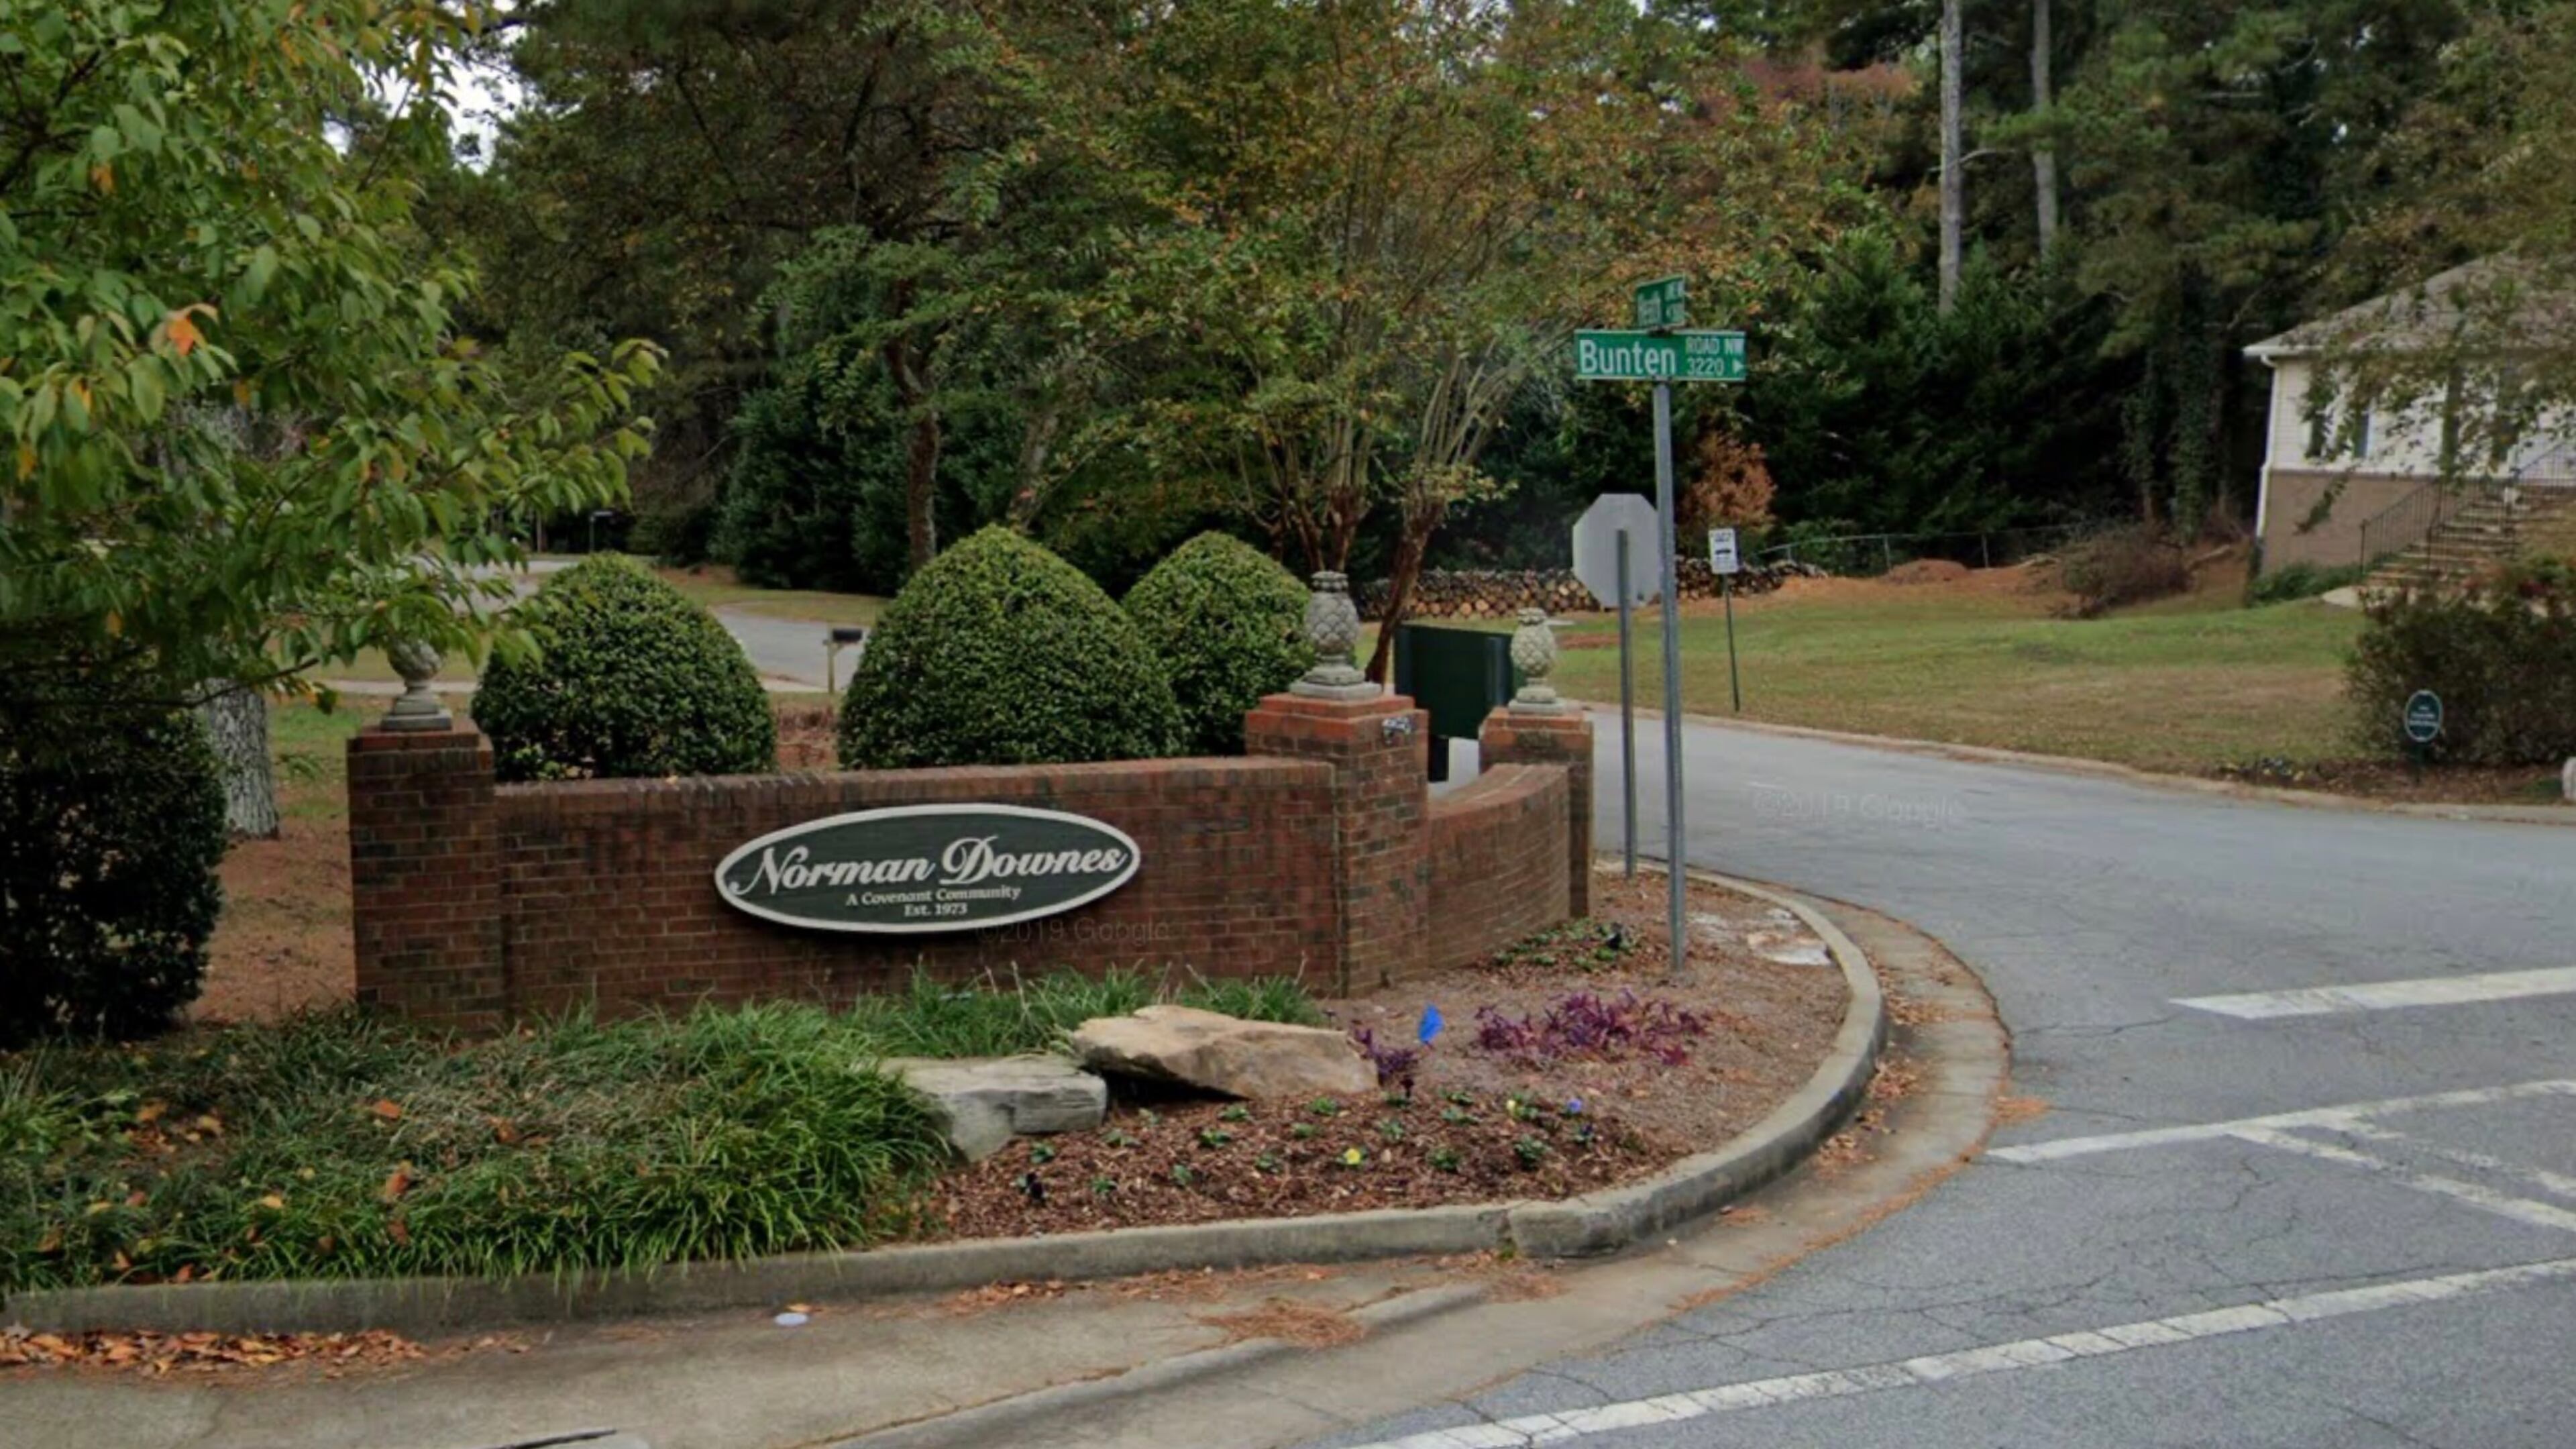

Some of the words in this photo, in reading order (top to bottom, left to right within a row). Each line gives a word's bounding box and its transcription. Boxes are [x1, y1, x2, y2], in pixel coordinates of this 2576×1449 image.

[1685, 337, 1720, 354] ROAD
[1724, 338, 1744, 355] NW
[1579, 339, 1676, 375] Bunten
[1686, 358, 1724, 376] 3220
[728, 845, 936, 895] Norman
[939, 835, 1128, 885] Downes
[846, 894, 859, 906] A
[861, 890, 932, 905] Covenant
[936, 885, 1022, 901] Community
[904, 904, 931, 917] Est.
[935, 903, 968, 915] 1973
